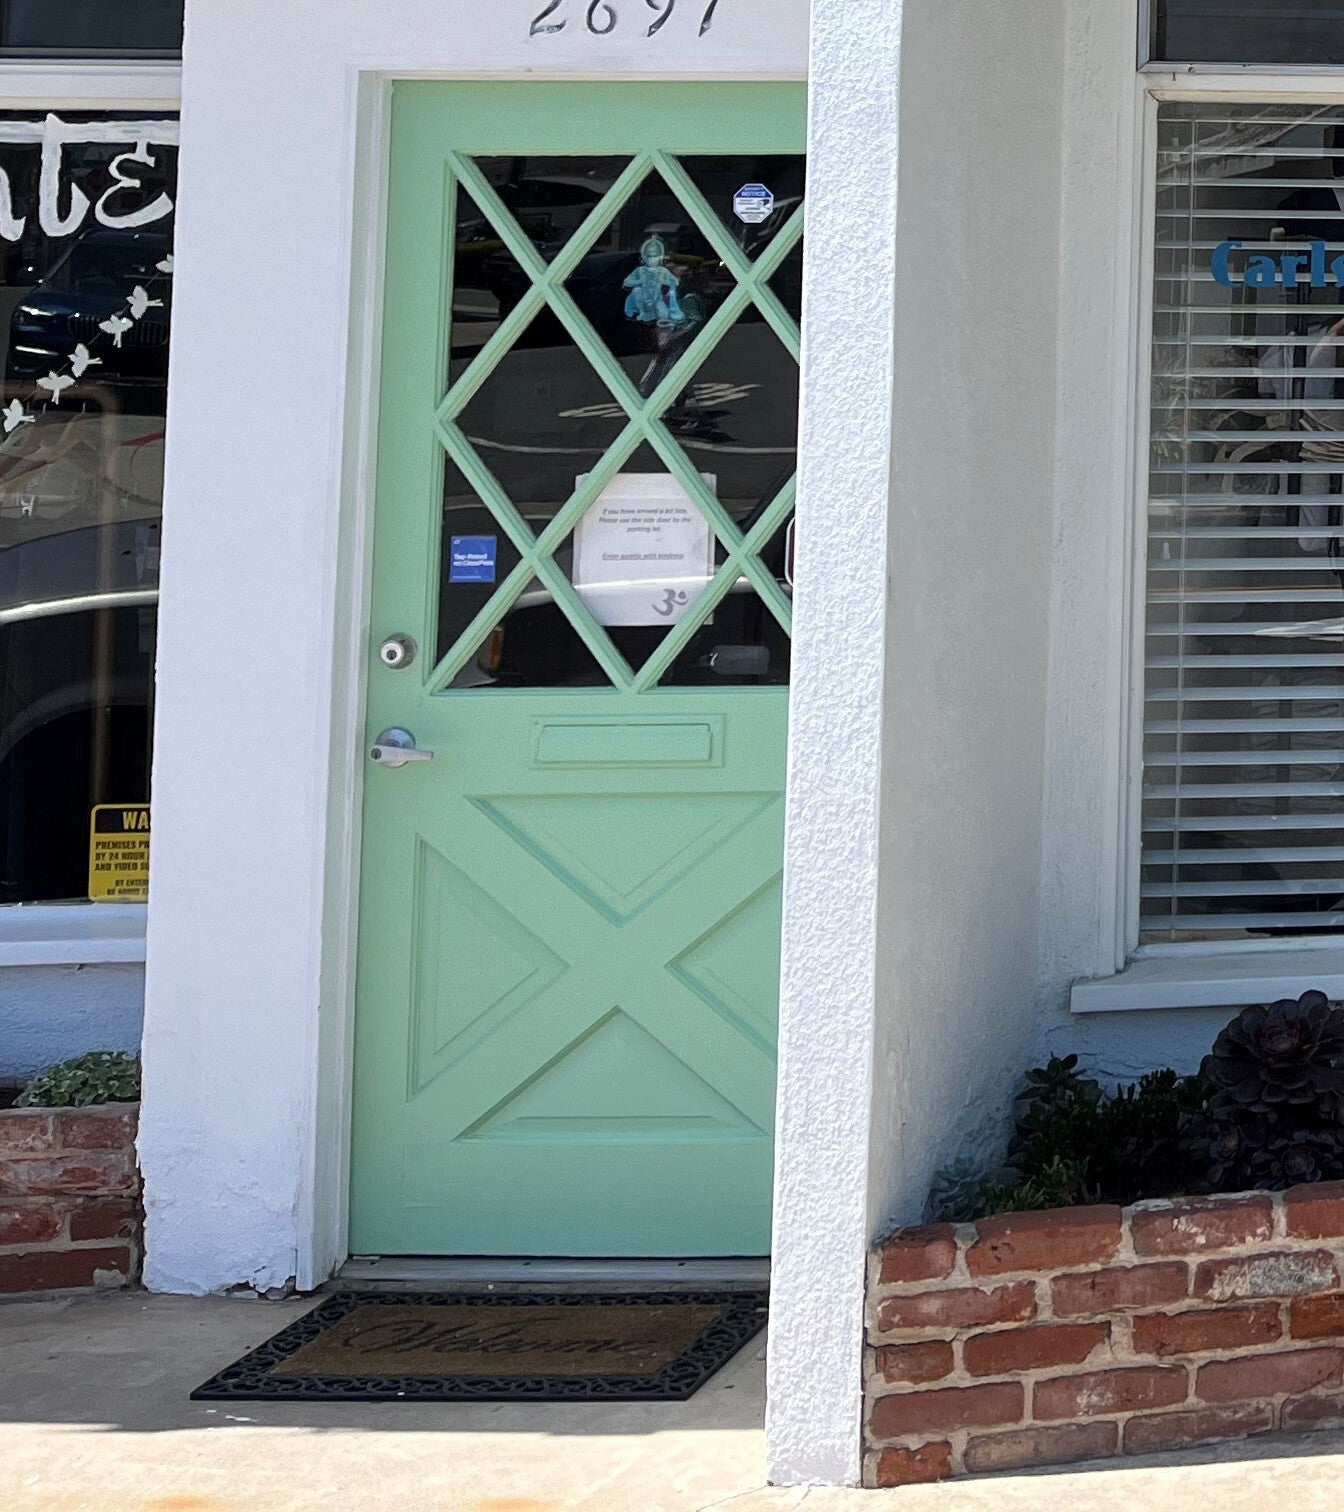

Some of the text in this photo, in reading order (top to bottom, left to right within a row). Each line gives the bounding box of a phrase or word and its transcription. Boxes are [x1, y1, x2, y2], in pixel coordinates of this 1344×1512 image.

[95, 840, 136, 850] PREMISES
[95, 852, 106, 861] BY
[108, 852, 119, 860] 24
[121, 852, 145, 861] HOUR
